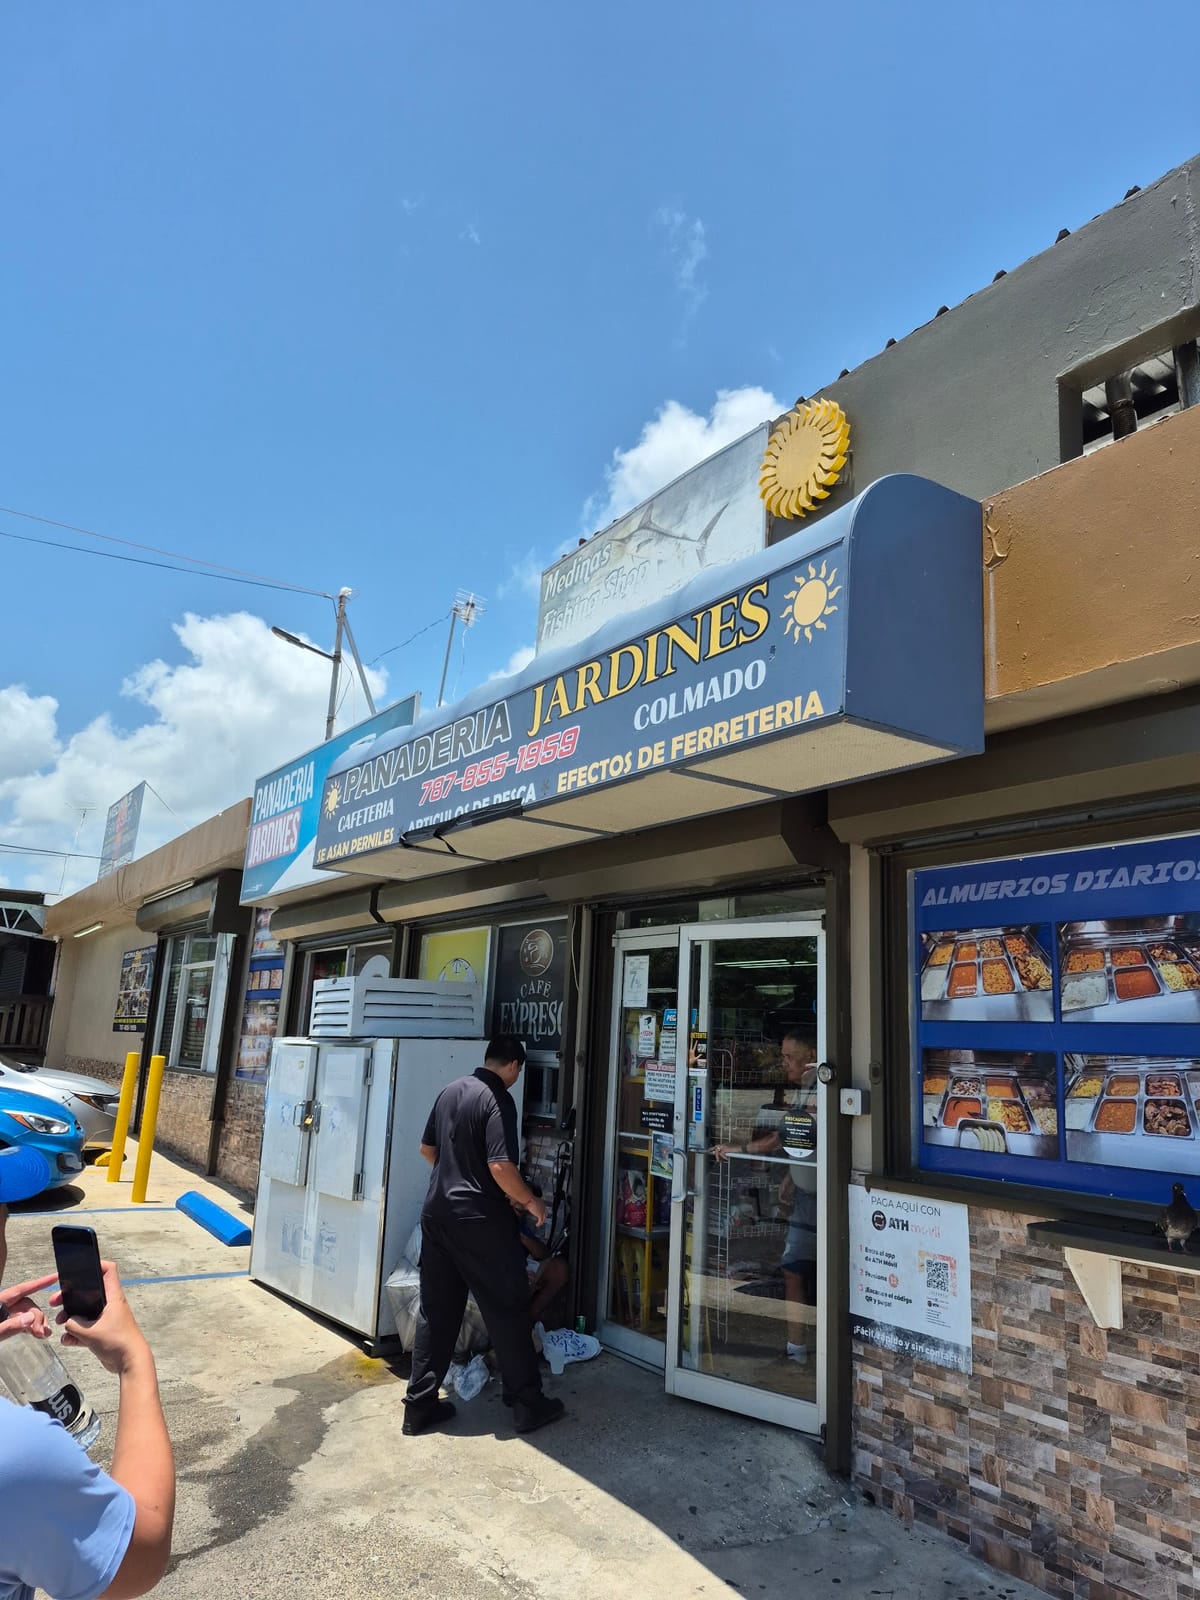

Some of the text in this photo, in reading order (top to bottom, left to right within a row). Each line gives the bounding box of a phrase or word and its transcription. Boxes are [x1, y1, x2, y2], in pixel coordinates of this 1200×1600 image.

[544, 543, 613, 602] Medinas
[342, 579, 771, 805] PANADERIA JARDINES
[633, 659, 767, 731] COLMADO
[253, 760, 315, 824] PANADERIA
[316, 847, 326, 864] SE
[327, 840, 350, 861] ASAN
[350, 827, 395, 854] PERNILES
[556, 751, 633, 794] EFECTOS
[637, 741, 666, 771] DE
[670, 690, 825, 760] FERRETERIA
[418, 725, 581, 807] 787-855-1959
[248, 810, 300, 866] JARDINES
[337, 798, 394, 833] CAFETERIA
[921, 873, 1070, 907] ALMUERZOS
[520, 980, 552, 998] CAFÉ
[871, 1196, 941, 1217] PAGA AQUÍ CON
[888, 1217, 909, 1232] ATH
[904, 1341, 910, 1350] y
[910, 1342, 925, 1353] sin
